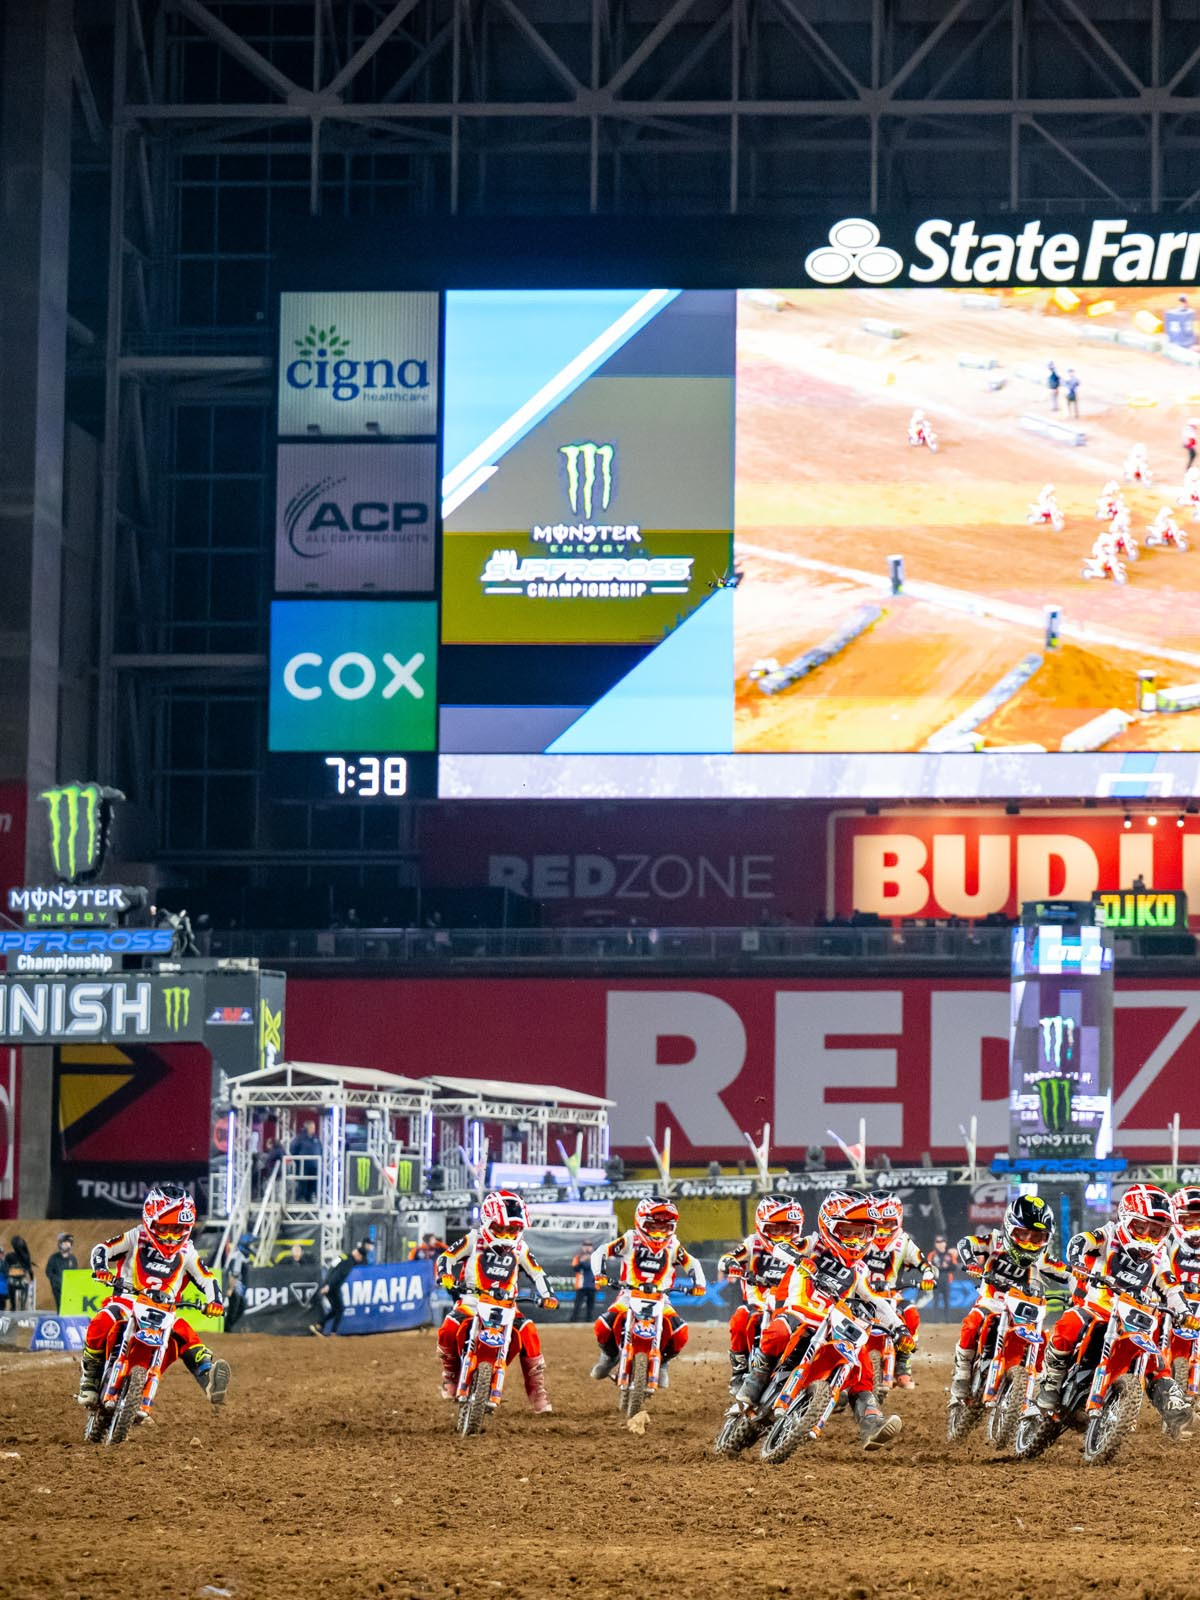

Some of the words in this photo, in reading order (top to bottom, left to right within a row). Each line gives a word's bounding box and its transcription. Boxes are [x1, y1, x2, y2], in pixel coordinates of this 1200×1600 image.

[286, 349, 429, 401] cigna
[308, 502, 429, 532] ACP
[533, 524, 643, 544] MONSTER
[527, 582, 647, 598] CHAMPIONSHIP
[283, 652, 424, 701] COX
[325, 758, 407, 796] 7:38
[852, 834, 1099, 918] BUD
[9, 887, 126, 911] MONSTER
[28, 913, 107, 922] ENERGY
[0, 931, 174, 951] PERCROSS
[17, 954, 112, 973] Championship
[486, 1252, 513, 1267] TLD
[820, 1256, 851, 1280] TLD
[996, 1259, 1026, 1279] TLD
[1116, 1270, 1143, 1287] KTM
[342, 1275, 424, 1308] AMAHA
